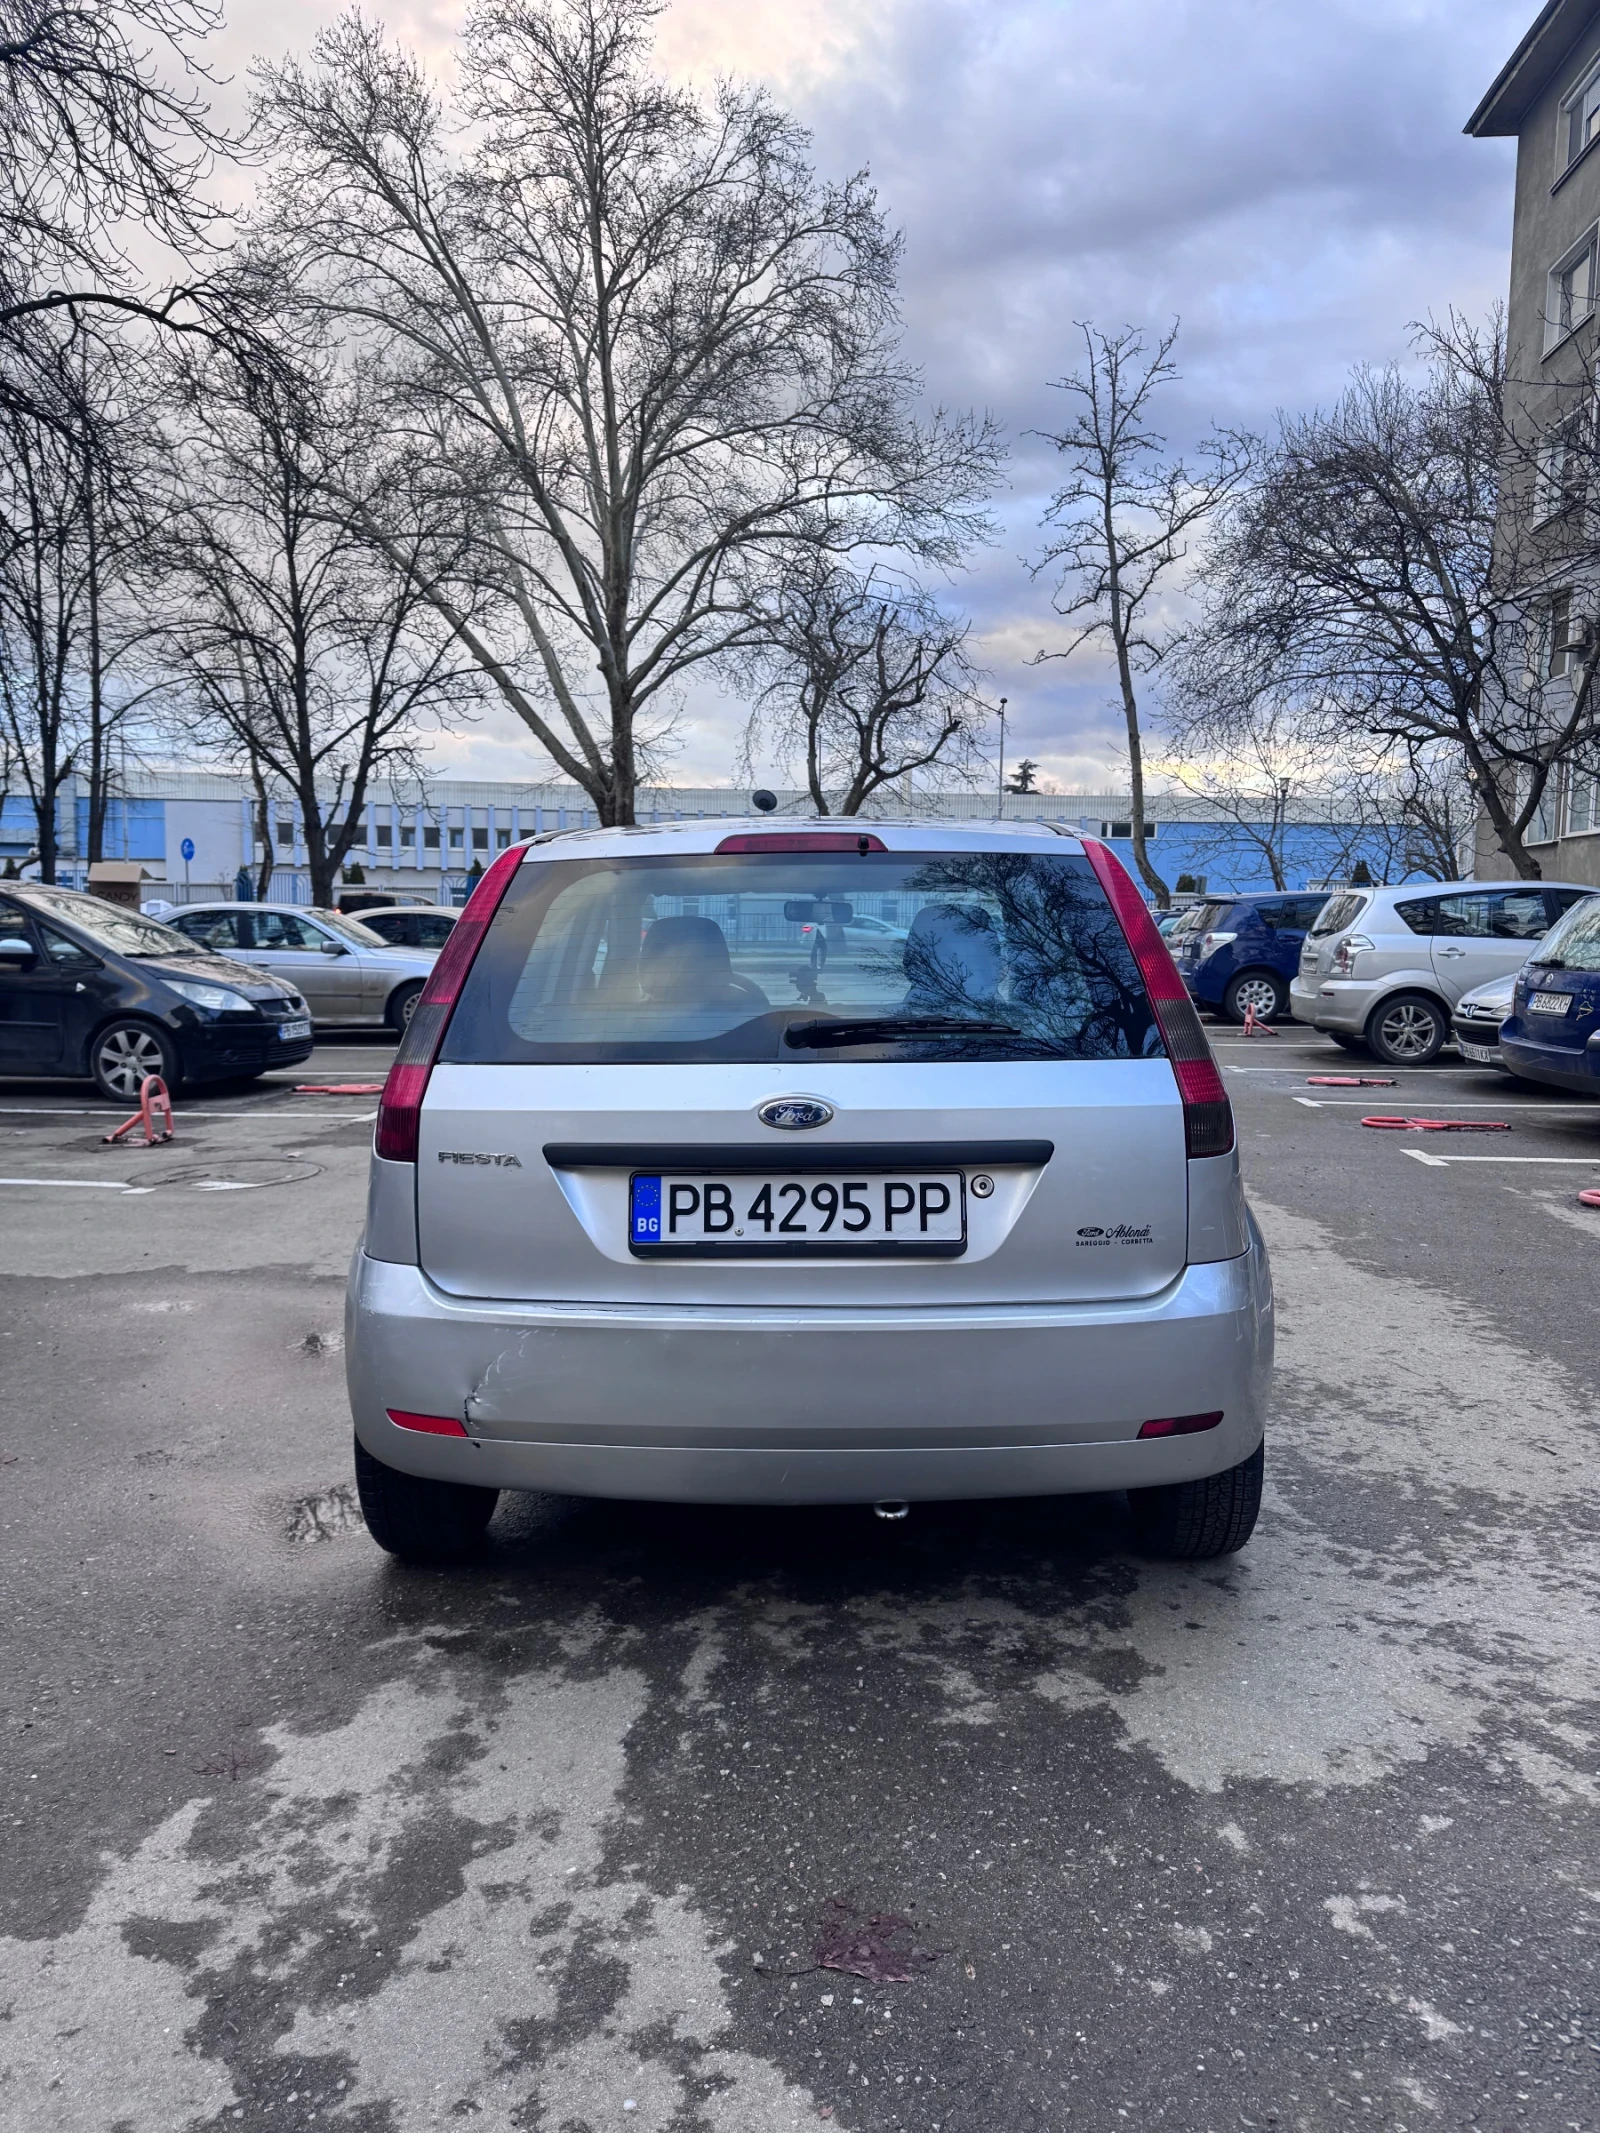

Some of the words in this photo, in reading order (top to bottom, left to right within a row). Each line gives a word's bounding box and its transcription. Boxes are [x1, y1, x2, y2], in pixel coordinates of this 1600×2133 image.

[774, 1104, 815, 1122] Ford
[438, 1151, 522, 1167] FIESTA
[669, 1183, 734, 1233] PB
[747, 1182, 871, 1233] 4295
[884, 1182, 950, 1232] PP
[637, 1217, 658, 1232] BG
[1080, 1227, 1101, 1237] Ford
